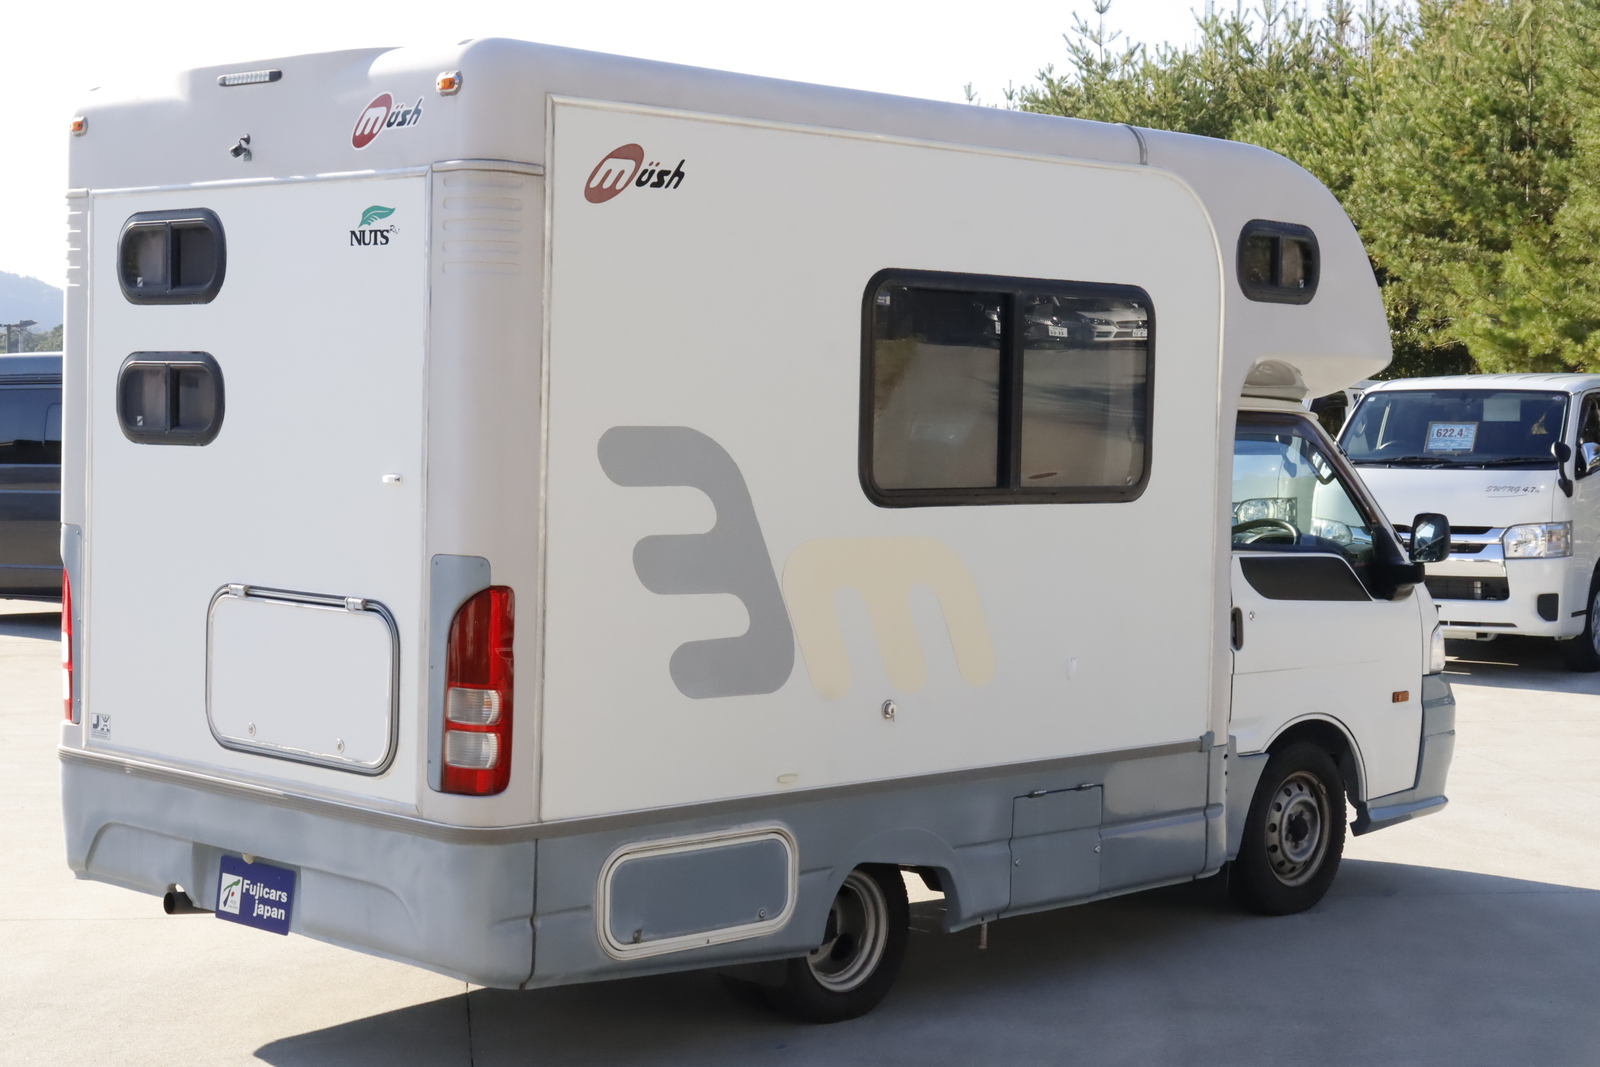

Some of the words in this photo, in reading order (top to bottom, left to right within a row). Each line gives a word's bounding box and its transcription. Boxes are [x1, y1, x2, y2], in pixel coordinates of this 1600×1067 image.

[349, 229, 390, 246] NUTS
[1436, 428, 1464, 438] 622.4
[1485, 485, 1521, 494] SWING
[243, 879, 288, 903] Fujicars
[253, 899, 286, 920] japan
